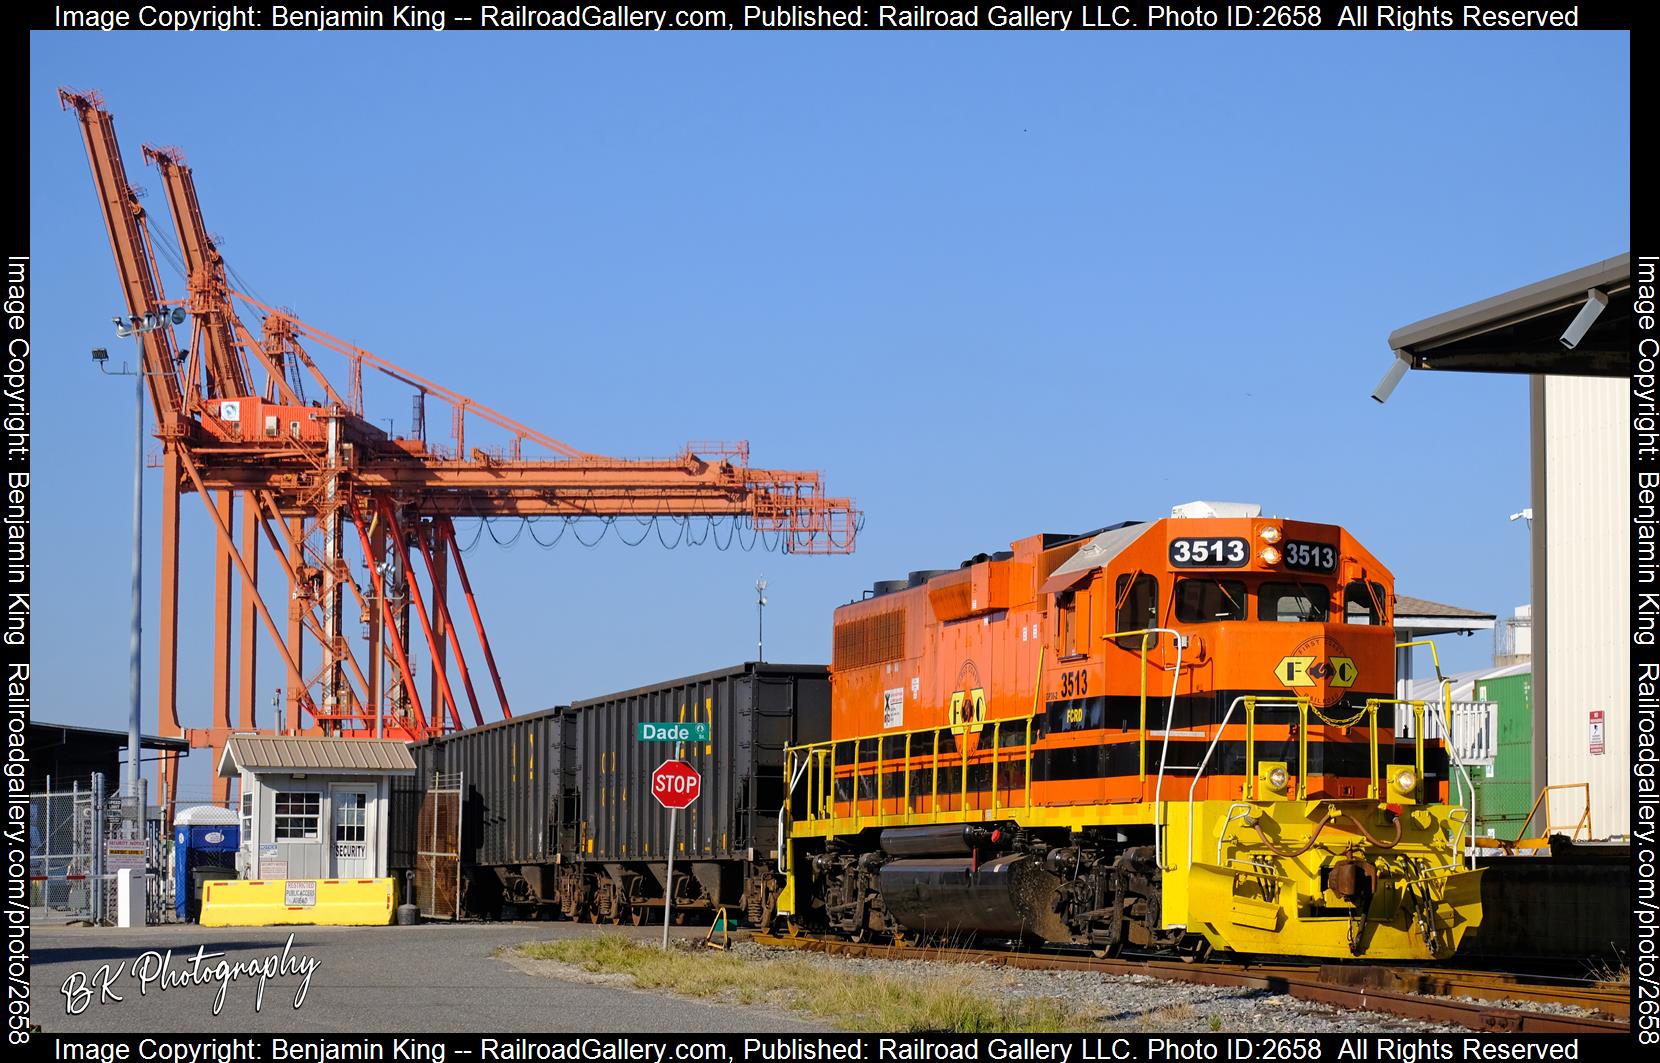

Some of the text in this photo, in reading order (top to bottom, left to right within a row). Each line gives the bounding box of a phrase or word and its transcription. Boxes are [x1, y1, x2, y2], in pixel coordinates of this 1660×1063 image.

[1174, 540, 1245, 562] 3513
[1286, 543, 1334, 568] 3513
[1298, 639, 1320, 655] FIRST
[1287, 662, 1352, 682] F C
[1061, 669, 1088, 698] 3513
[1066, 708, 1083, 723] FCRD
[643, 724, 690, 740] Dade
[655, 774, 697, 794] STOP
[336, 845, 366, 857] SECURITY
[286, 889, 315, 897] PUBLIC ACCESS
